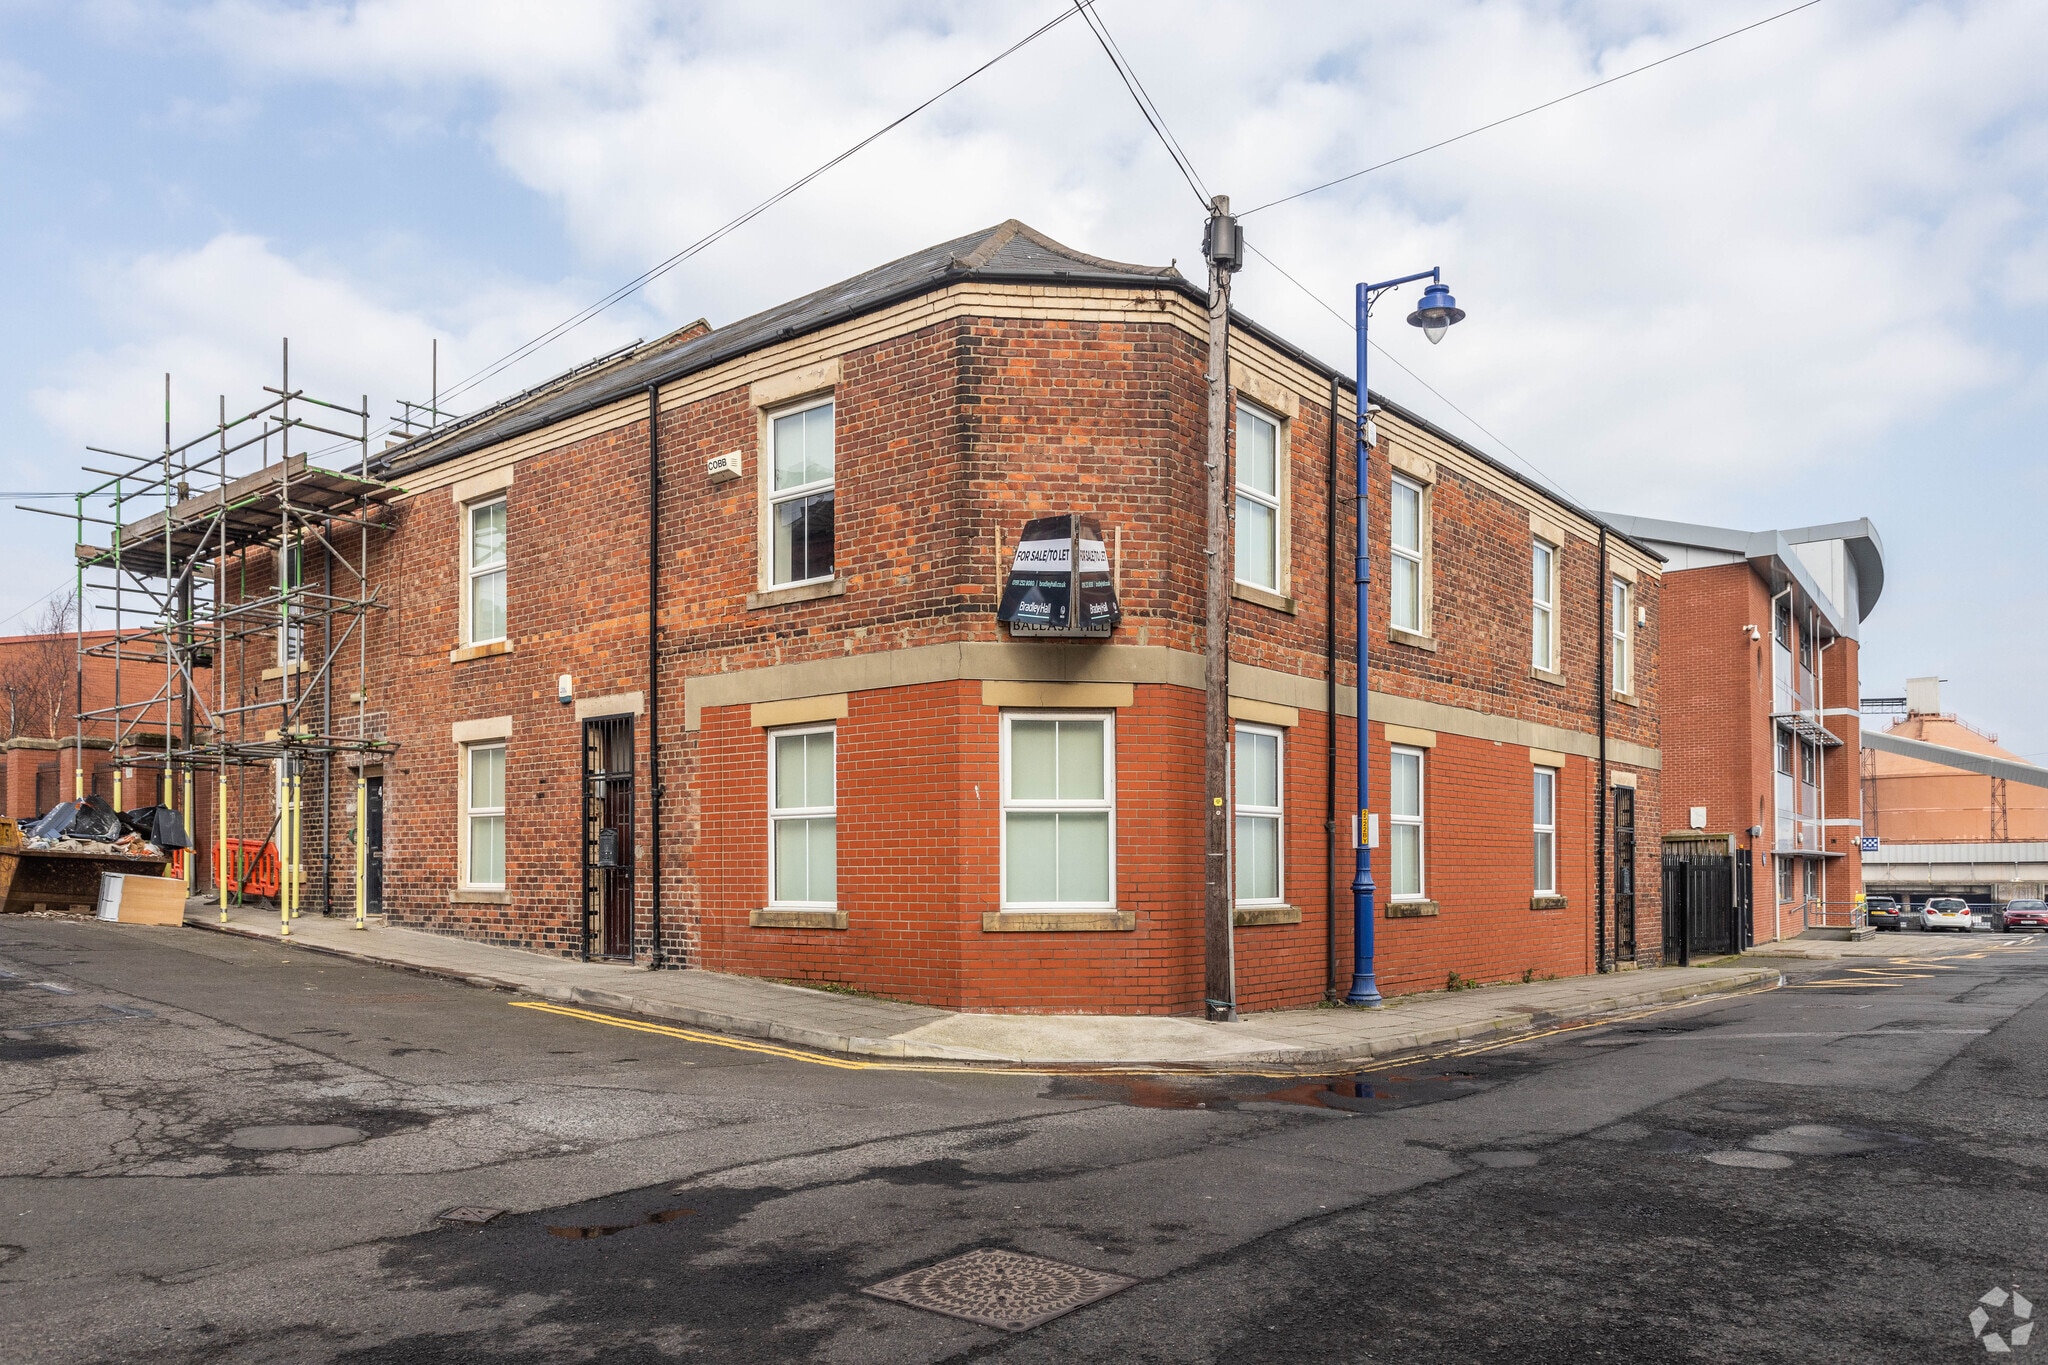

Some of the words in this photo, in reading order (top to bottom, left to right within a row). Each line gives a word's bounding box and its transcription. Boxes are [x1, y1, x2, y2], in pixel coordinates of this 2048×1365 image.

[708, 458, 727, 470] COBB
[1017, 550, 1030, 561] FOR
[1030, 548, 1058, 562] SALE/TO
[1059, 549, 1070, 561] LET
[378, 786, 382, 797] 4
